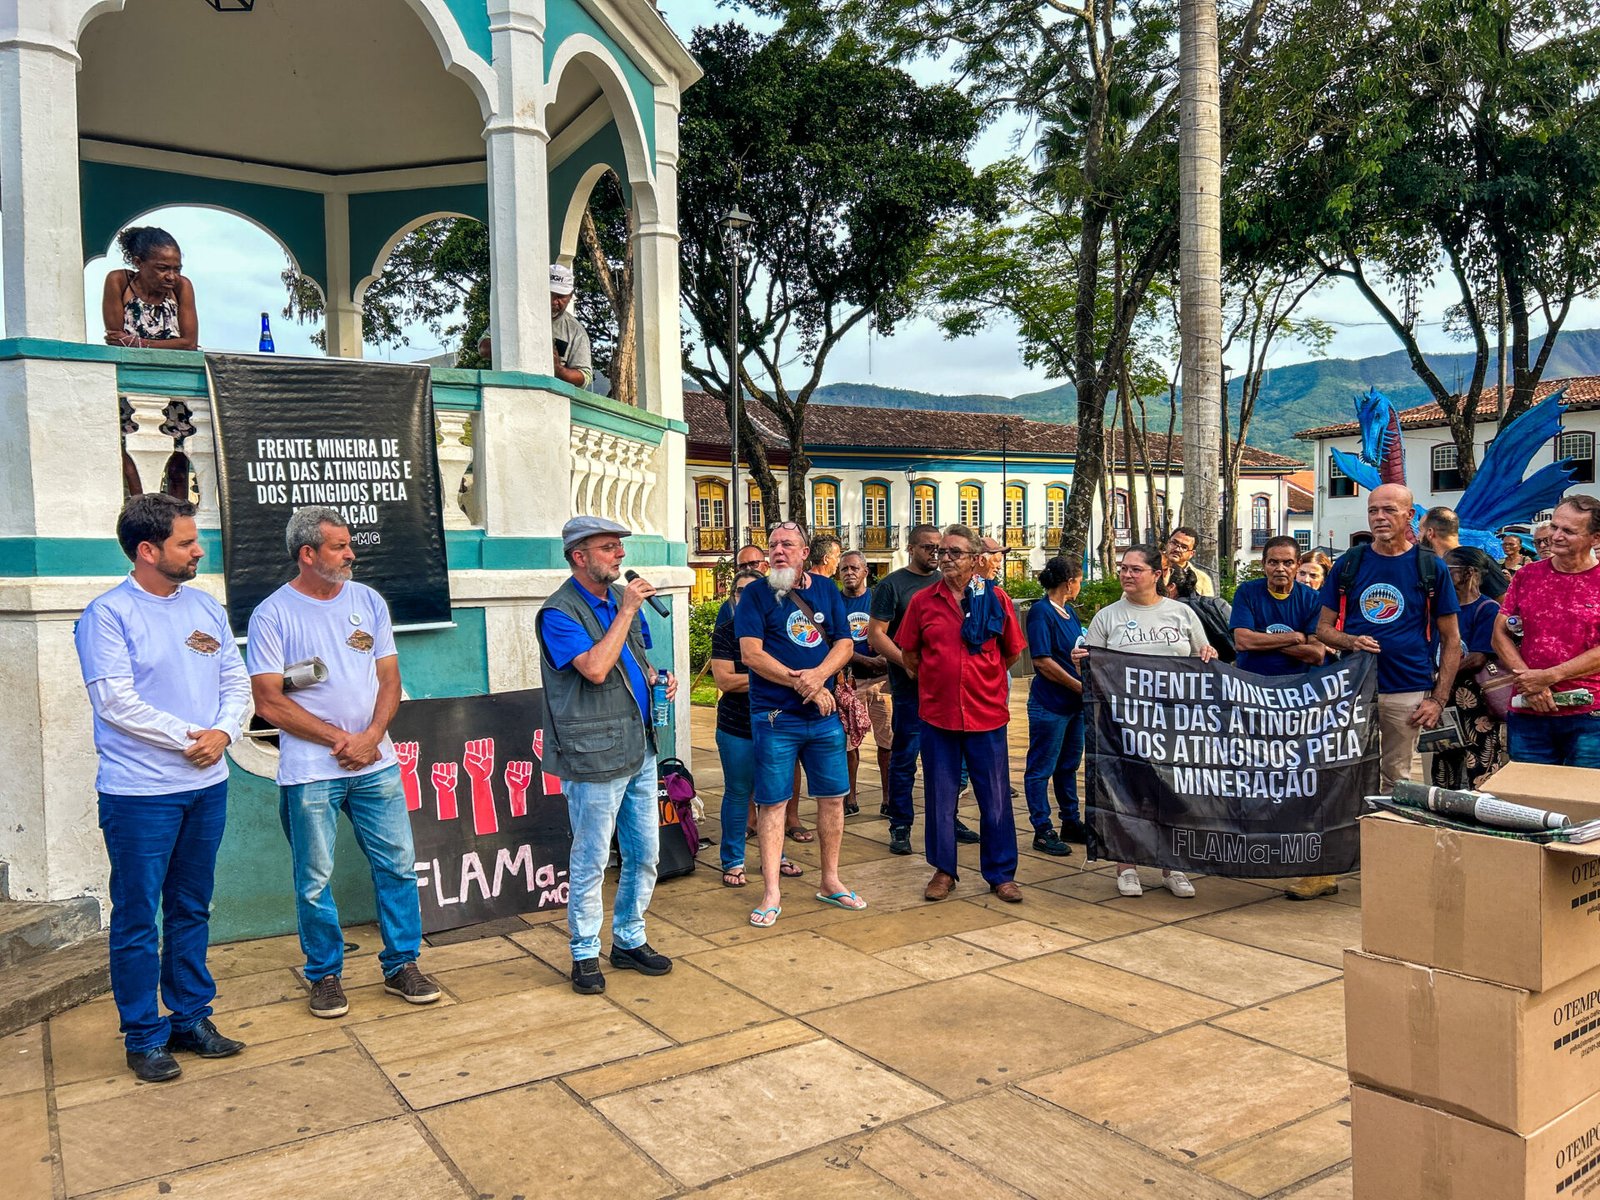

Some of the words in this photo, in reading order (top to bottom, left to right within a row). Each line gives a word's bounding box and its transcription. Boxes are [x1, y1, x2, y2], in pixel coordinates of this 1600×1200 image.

[257, 438, 313, 459] FRENTE
[316, 438, 378, 458] MINEIRA
[381, 438, 400, 458] DE
[248, 461, 286, 482] LUTA
[289, 461, 320, 481] DAS
[324, 460, 401, 481] ATINGIDAS
[403, 460, 412, 479] E
[257, 484, 287, 504] DOS
[292, 482, 369, 503] ATINGIDOS
[373, 482, 407, 501] PELA
[1125, 666, 1214, 700] FRENTE
[1221, 673, 1320, 709] MINEIRA
[1321, 668, 1353, 701] DE
[1111, 695, 1167, 730] LUTA
[1174, 703, 1222, 733] DAS
[1228, 700, 1350, 736] ATINGIDAS
[1353, 694, 1366, 724] E
[1121, 727, 1167, 760] DOS
[1173, 735, 1301, 768] ATINGIDOS
[1306, 729, 1363, 764] PELA
[1173, 766, 1318, 804] MINERAÇÃO
[1172, 828, 1322, 864] FLAMa-MG
[1553, 1007, 1563, 1026] O
[1556, 1149, 1565, 1169] O
